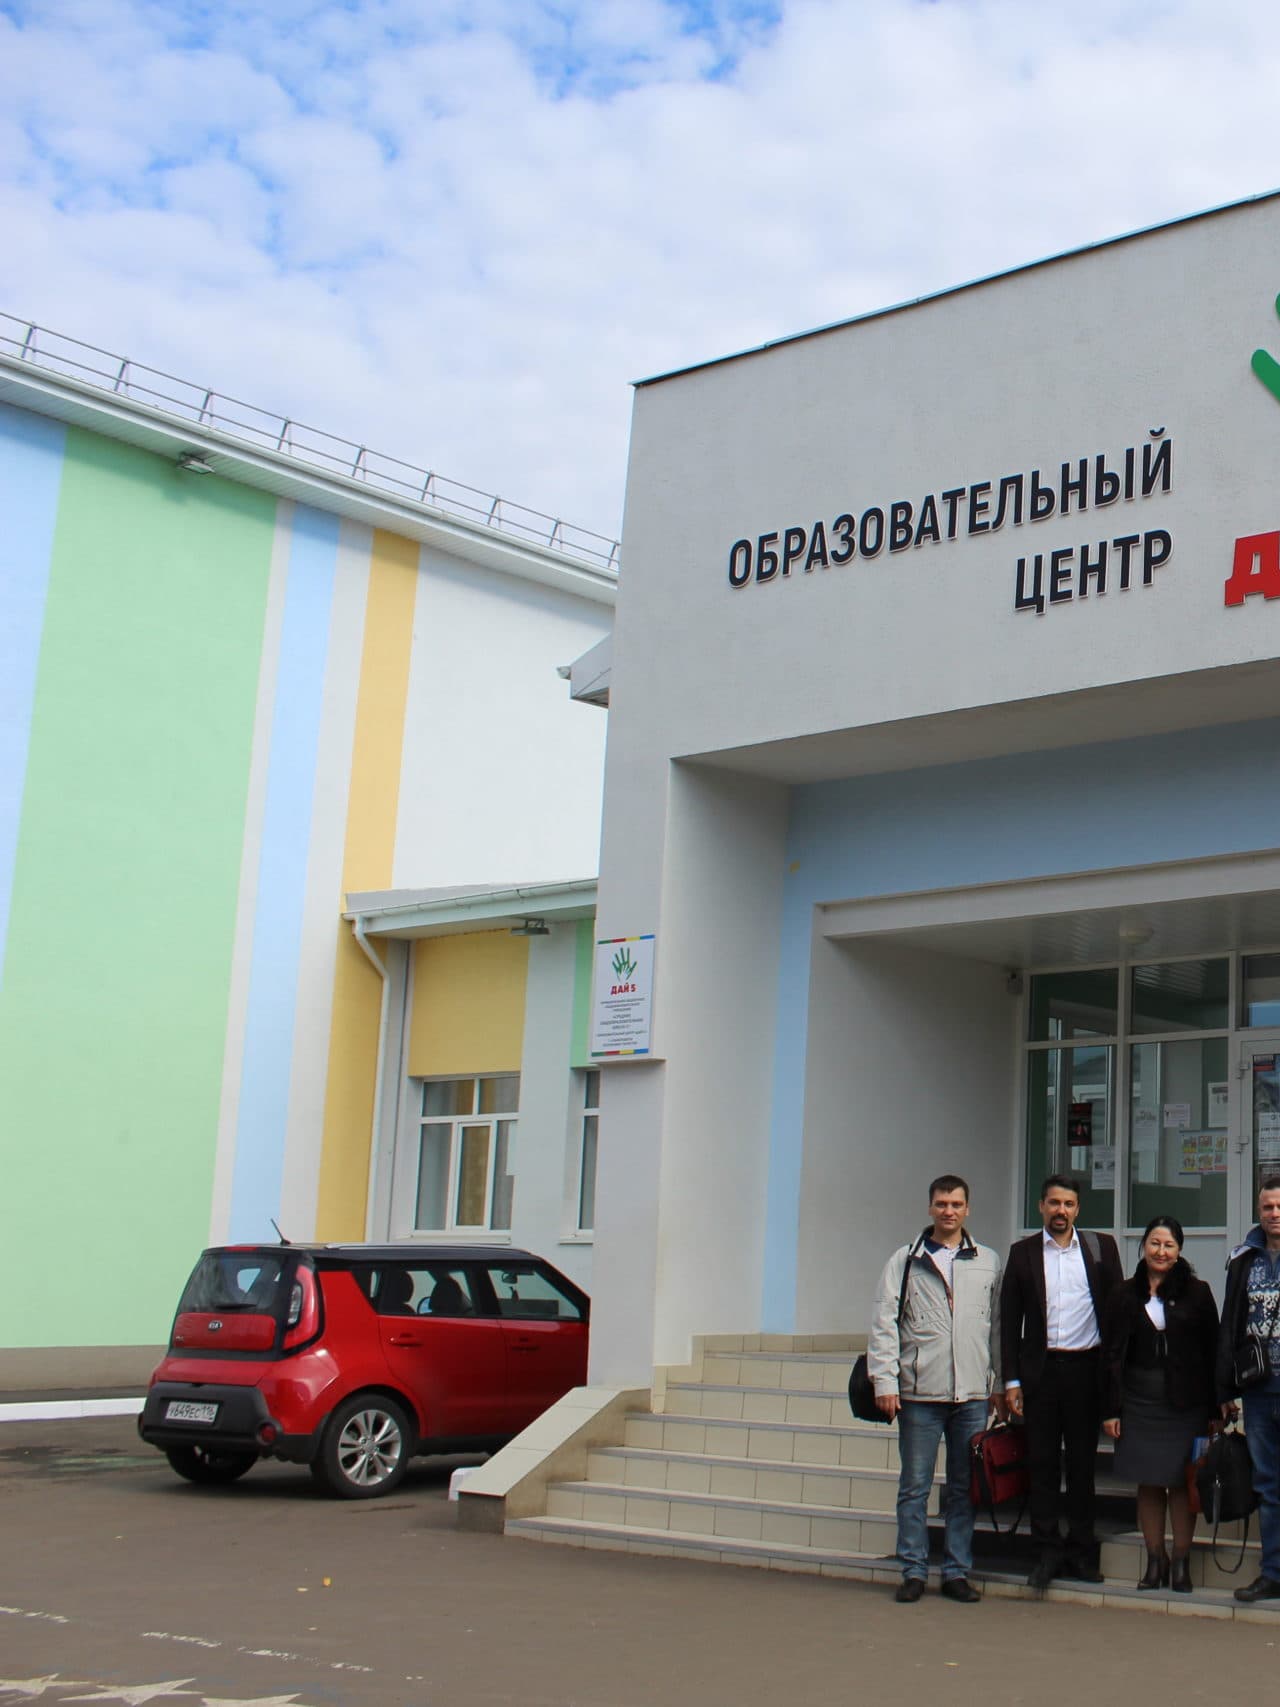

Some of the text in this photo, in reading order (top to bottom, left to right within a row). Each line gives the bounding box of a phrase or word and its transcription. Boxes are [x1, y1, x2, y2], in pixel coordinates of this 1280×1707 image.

[729, 427, 1174, 588] ОБРАЗОВАТЕЛЬНЫЙ
[1013, 529, 1173, 615] ЦЕНТР
[611, 982, 637, 995] ДАЙ 5
